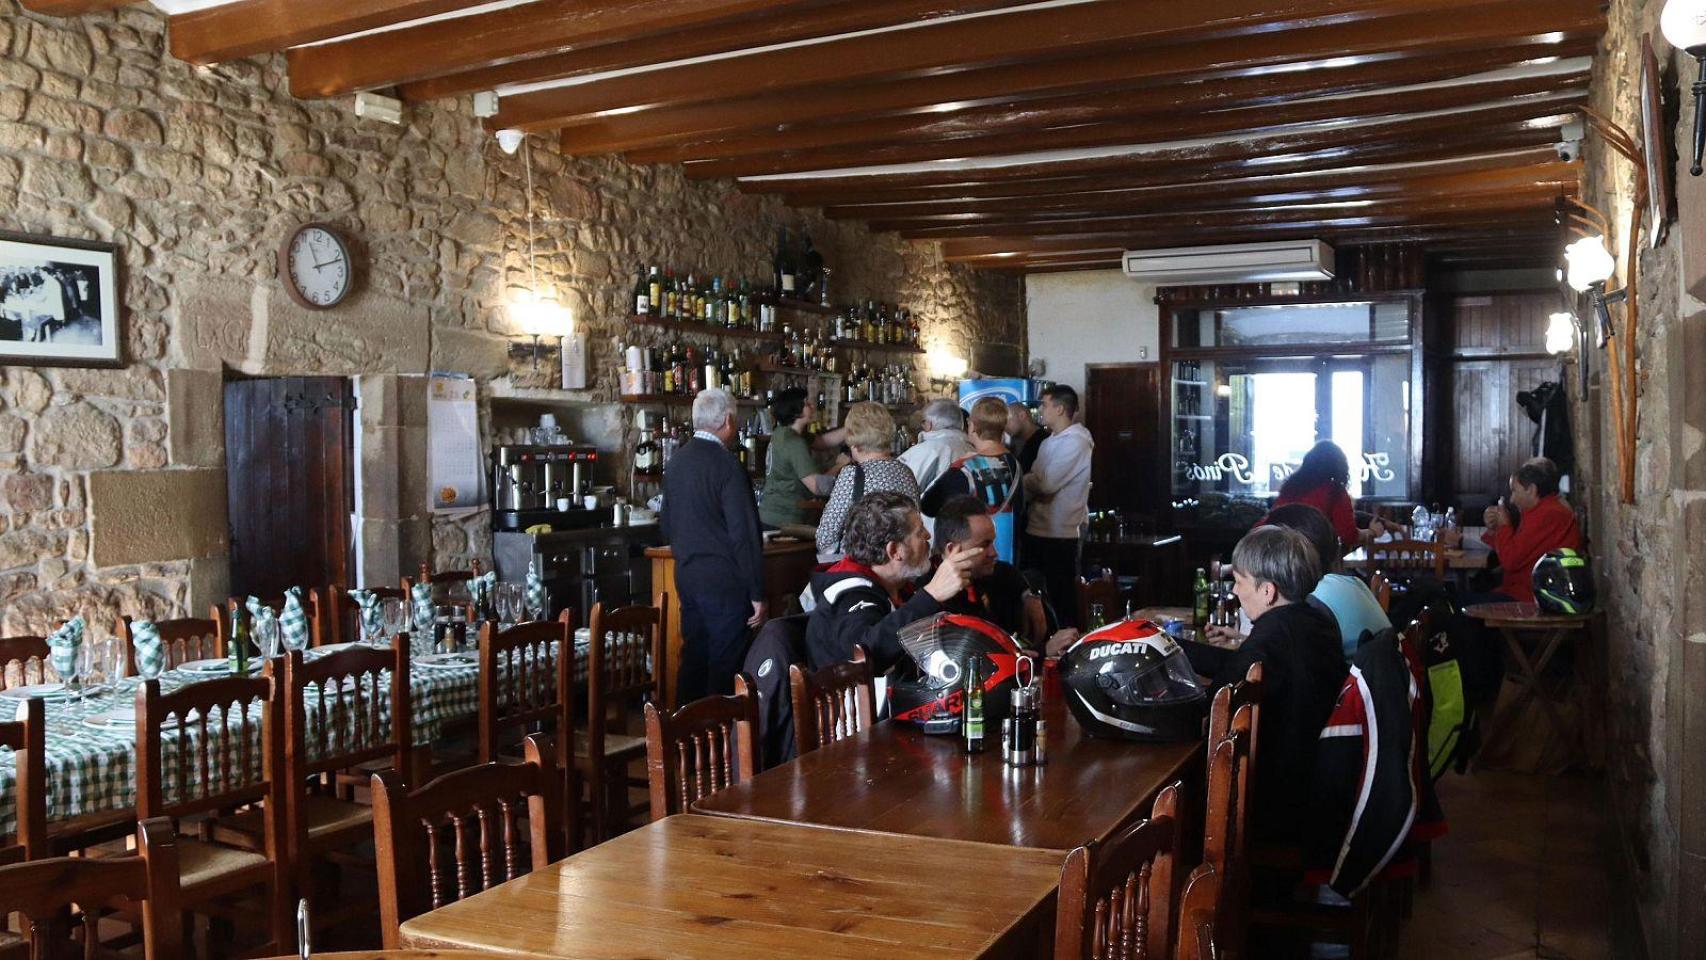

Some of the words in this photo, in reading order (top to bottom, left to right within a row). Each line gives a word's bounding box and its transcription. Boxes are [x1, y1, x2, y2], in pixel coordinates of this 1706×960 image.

[301, 231, 307, 243] 11
[313, 230, 322, 242] 12
[335, 249, 341, 260] 2
[337, 266, 343, 278] 3
[333, 281, 339, 292] 4
[312, 291, 319, 304] 6
[324, 290, 331, 302] 5
[1090, 643, 1147, 660] DUCATI
